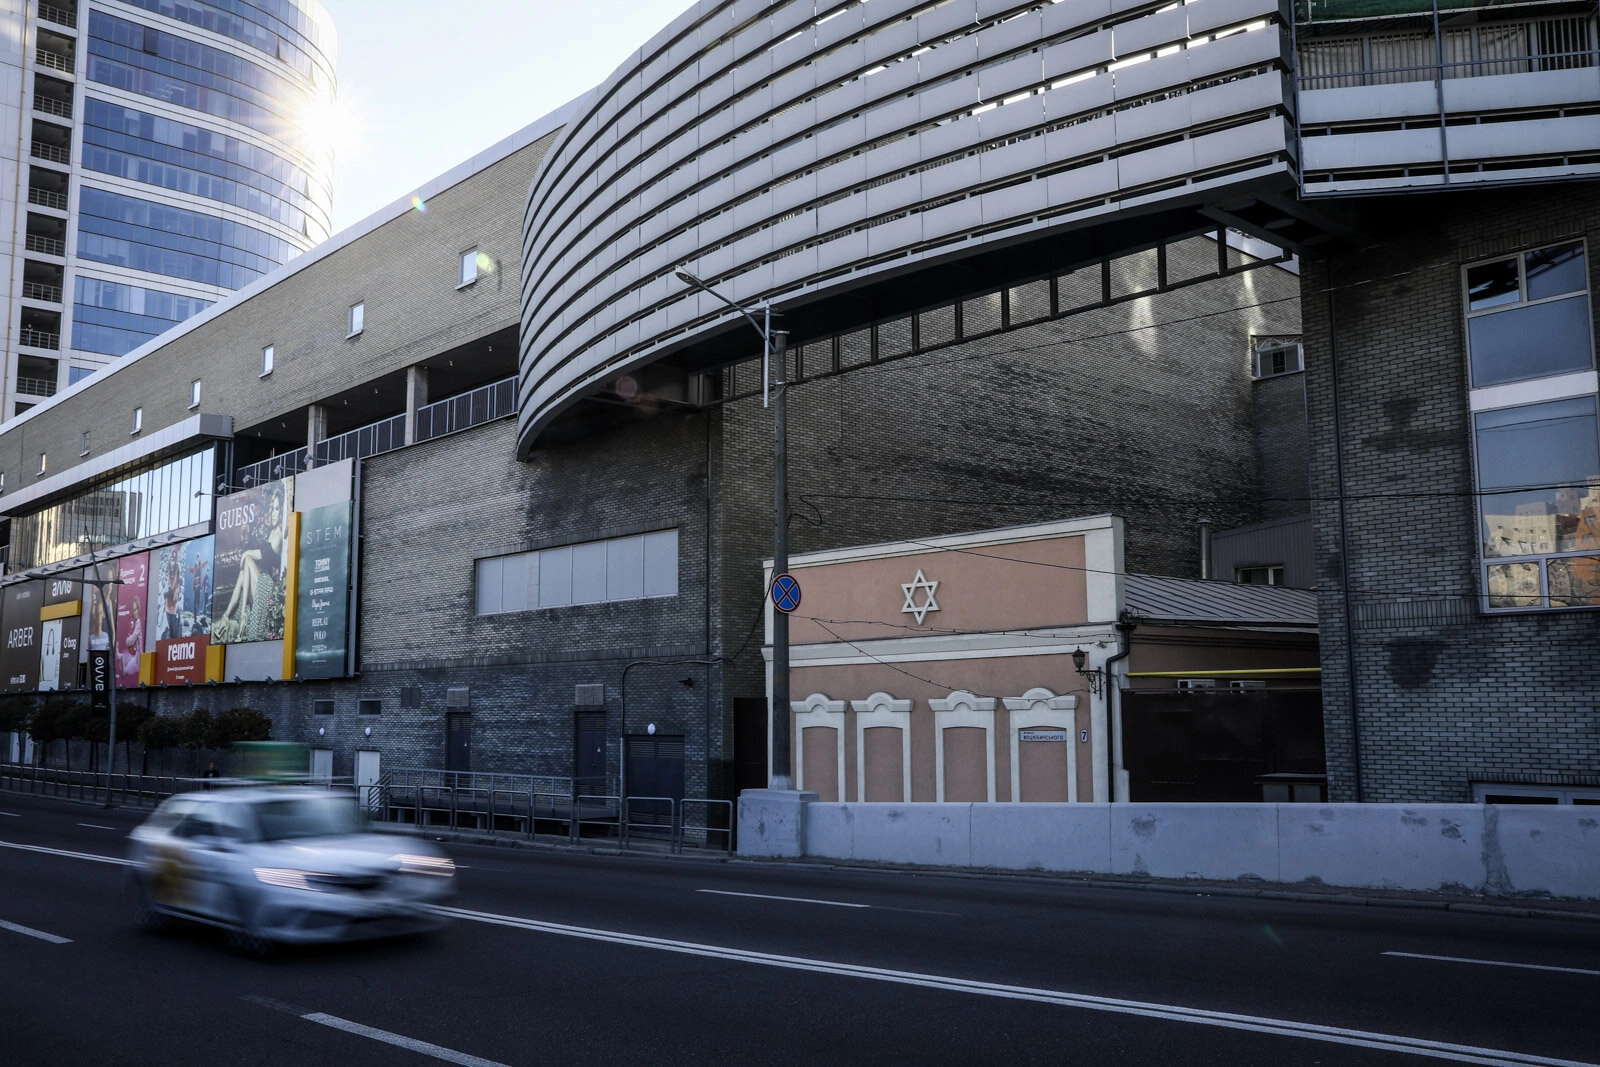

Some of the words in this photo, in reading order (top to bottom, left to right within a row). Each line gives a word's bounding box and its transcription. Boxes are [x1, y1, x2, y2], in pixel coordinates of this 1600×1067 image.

[220, 504, 255, 530] GUESS
[306, 525, 342, 545] STEM
[139, 564, 145, 581] 2
[312, 617, 329, 627] REPLAY
[8, 626, 34, 648] ARBER
[168, 642, 195, 661] reima
[1081, 731, 1087, 740] 7
